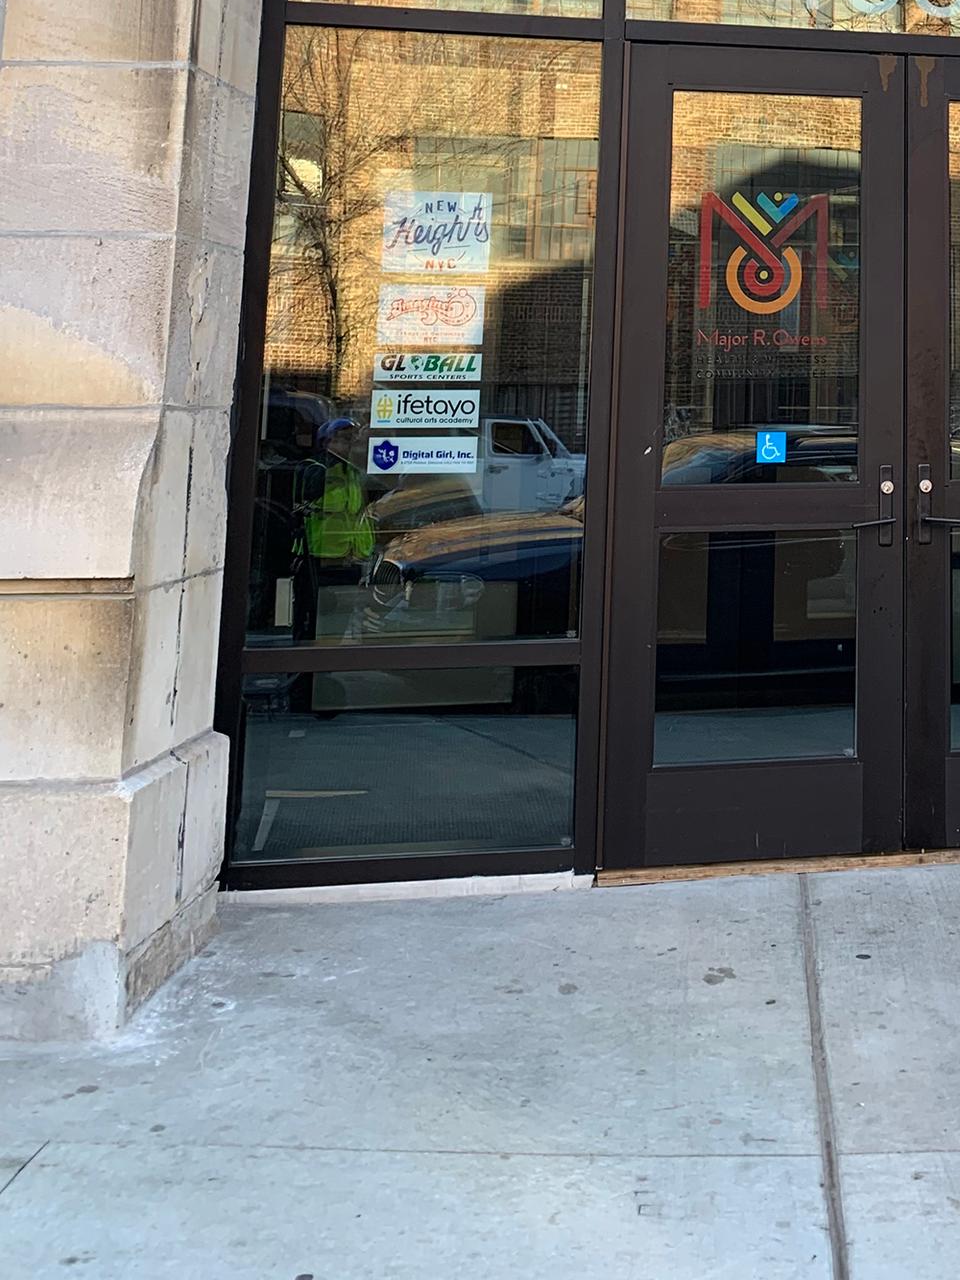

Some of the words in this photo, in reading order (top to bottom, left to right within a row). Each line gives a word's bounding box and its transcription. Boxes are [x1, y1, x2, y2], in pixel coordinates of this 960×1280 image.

[424, 200, 457, 214] NEW
[384, 193, 490, 257] Heights
[424, 259, 457, 271] NYC
[696, 328, 749, 352] Major
[753, 328, 771, 346] R.
[772, 328, 828, 346] Owens
[396, 393, 476, 417] ifetayo
[396, 416, 423, 424] cultural
[439, 417, 473, 425] academy
[402, 450, 434, 461] Digital
[435, 450, 455, 460] Girl,
[457, 450, 475, 460] Inc.
